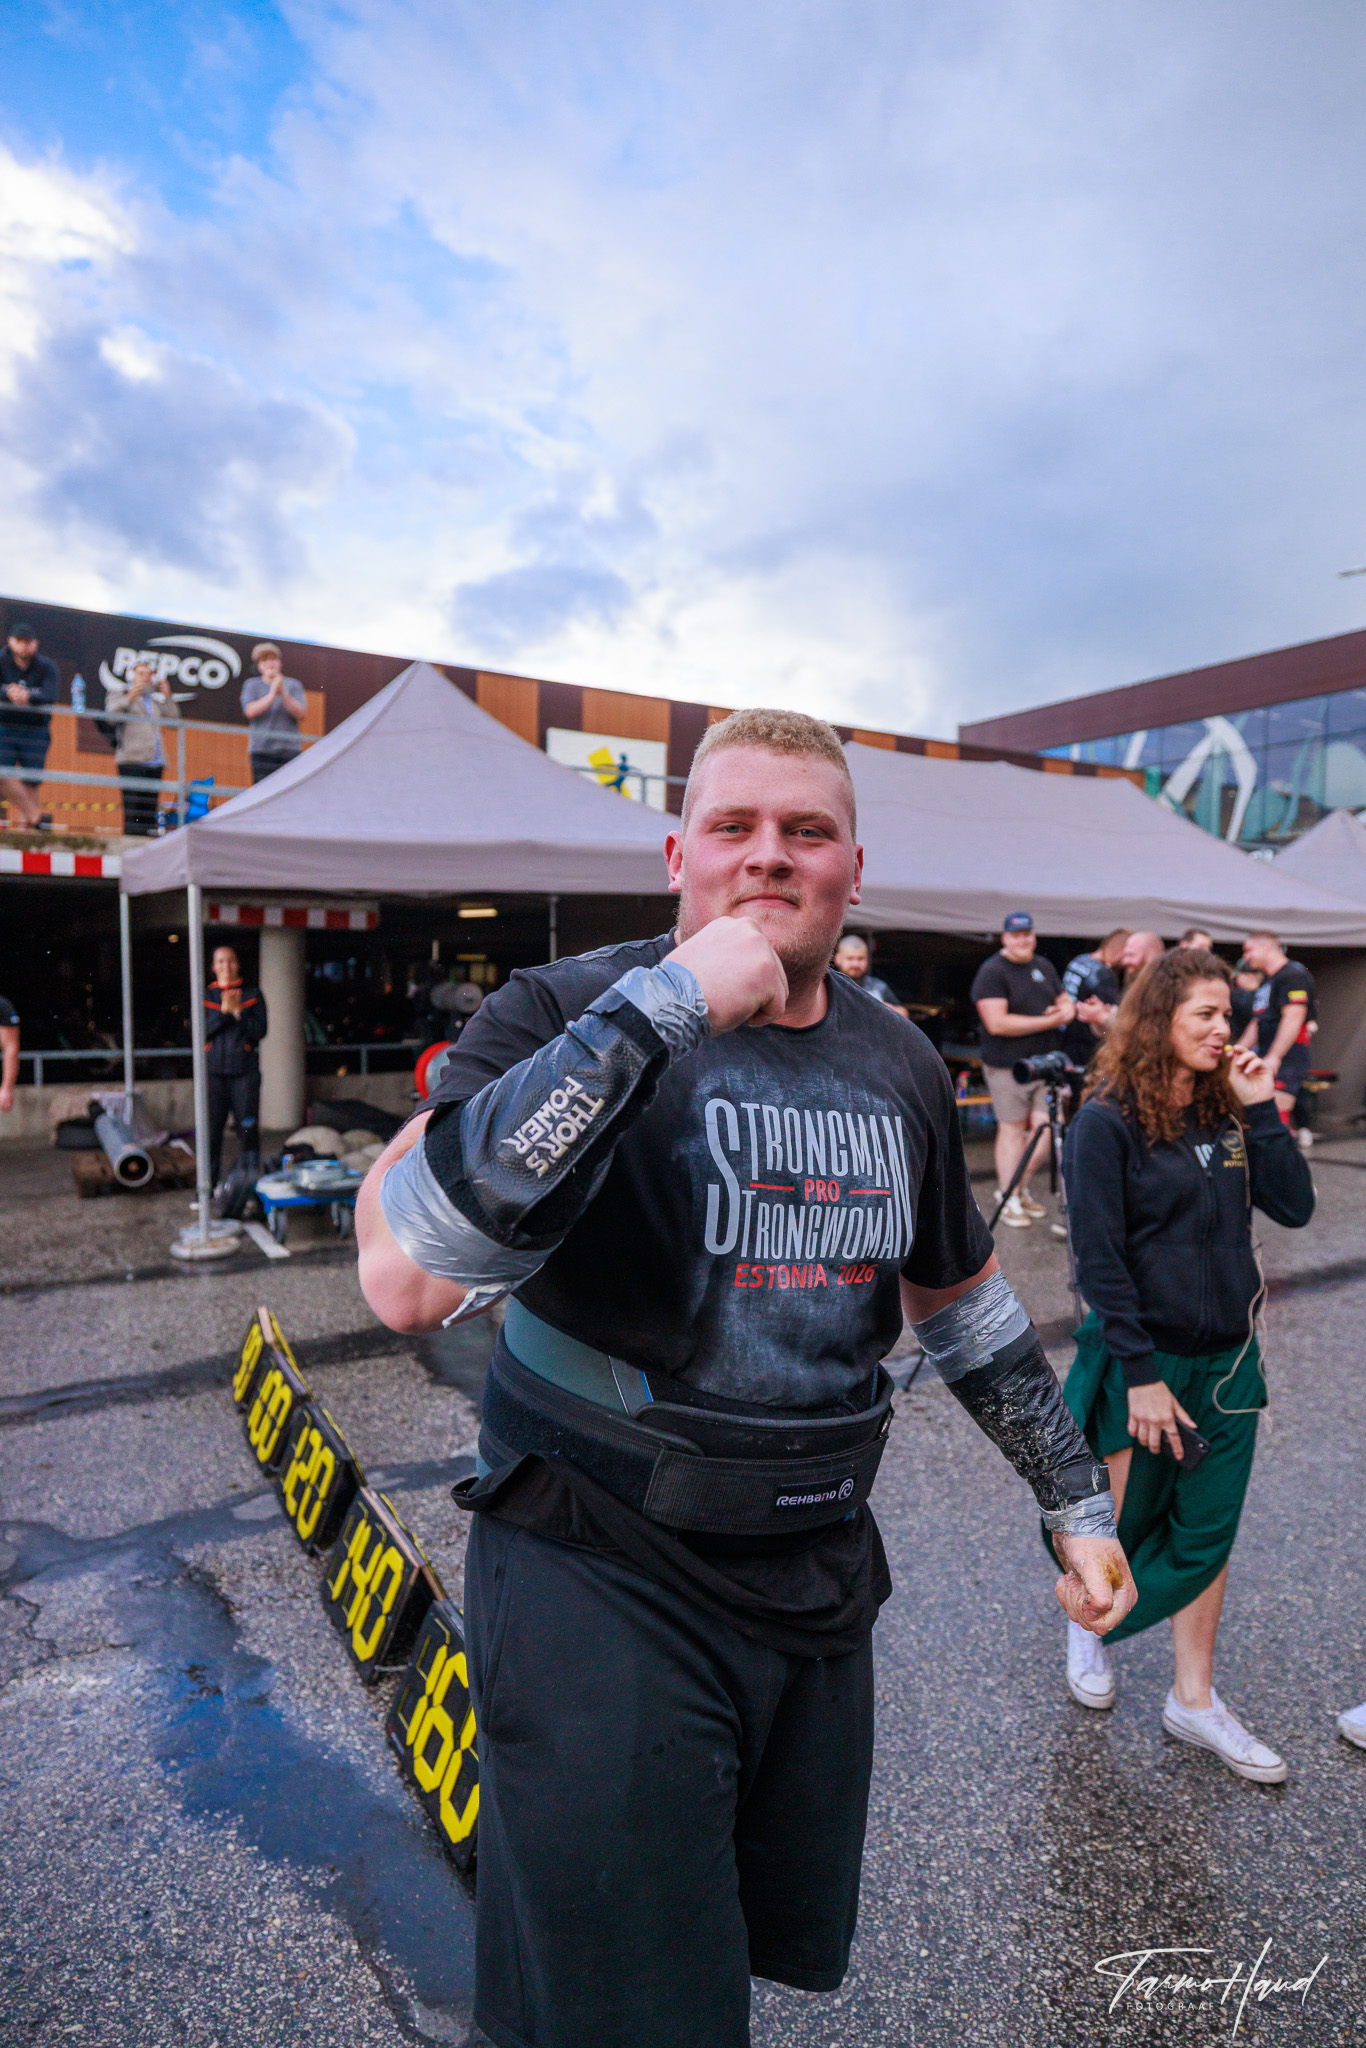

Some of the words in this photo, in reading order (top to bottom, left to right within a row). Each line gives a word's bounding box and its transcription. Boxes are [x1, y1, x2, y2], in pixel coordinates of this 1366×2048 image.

[501, 1075, 583, 1155] POWER
[526, 1091, 605, 1178] THOR'S
[704, 1098, 910, 1188] STRONGMAN
[704, 1184, 913, 1259] STRONGWOMAN
[804, 1178, 840, 1202] PRO
[734, 1264, 828, 1289] ESTONIA
[837, 1263, 879, 1286] 2026
[283, 1425, 336, 1541] 120
[331, 1518, 404, 1662] 140
